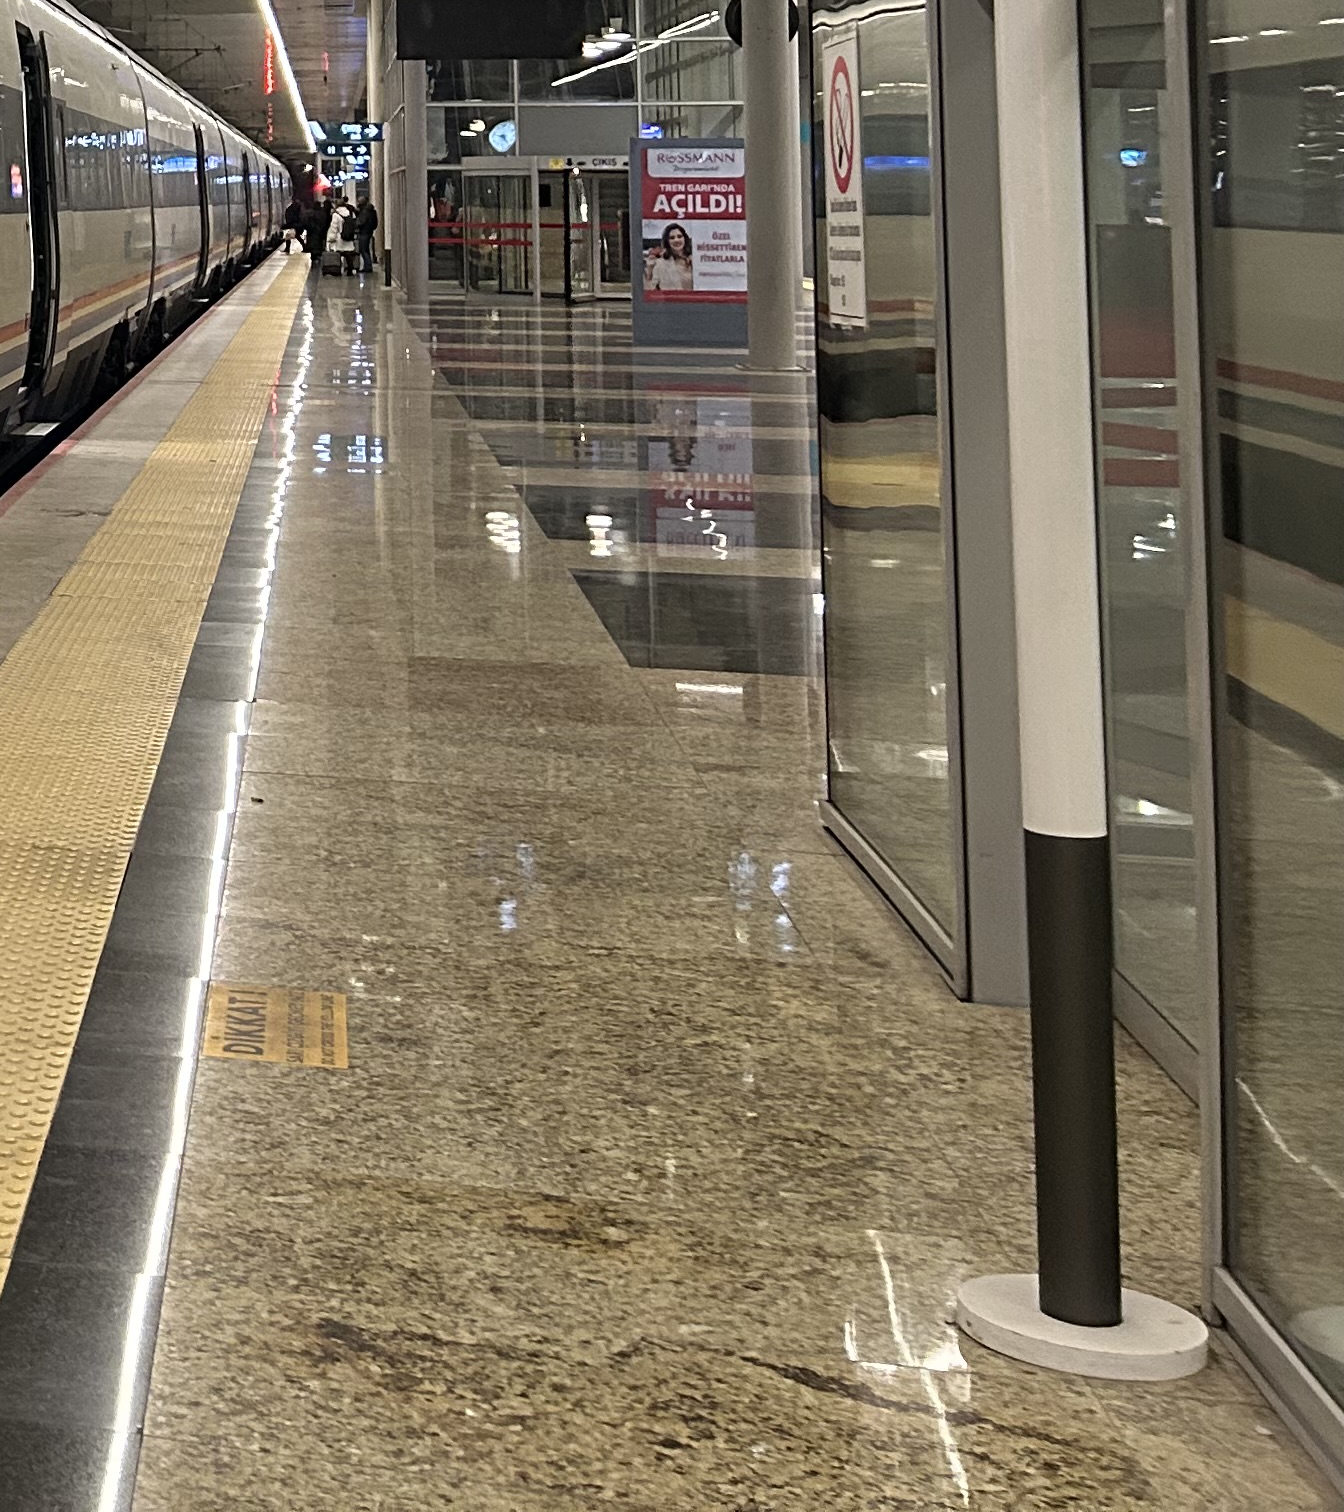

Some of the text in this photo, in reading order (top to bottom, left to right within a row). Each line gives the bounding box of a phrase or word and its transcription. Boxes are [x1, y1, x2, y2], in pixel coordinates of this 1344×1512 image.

[656, 152, 735, 164] ROSSMANN
[659, 183, 685, 192] TREN
[652, 193, 743, 219] AÇILDI!
